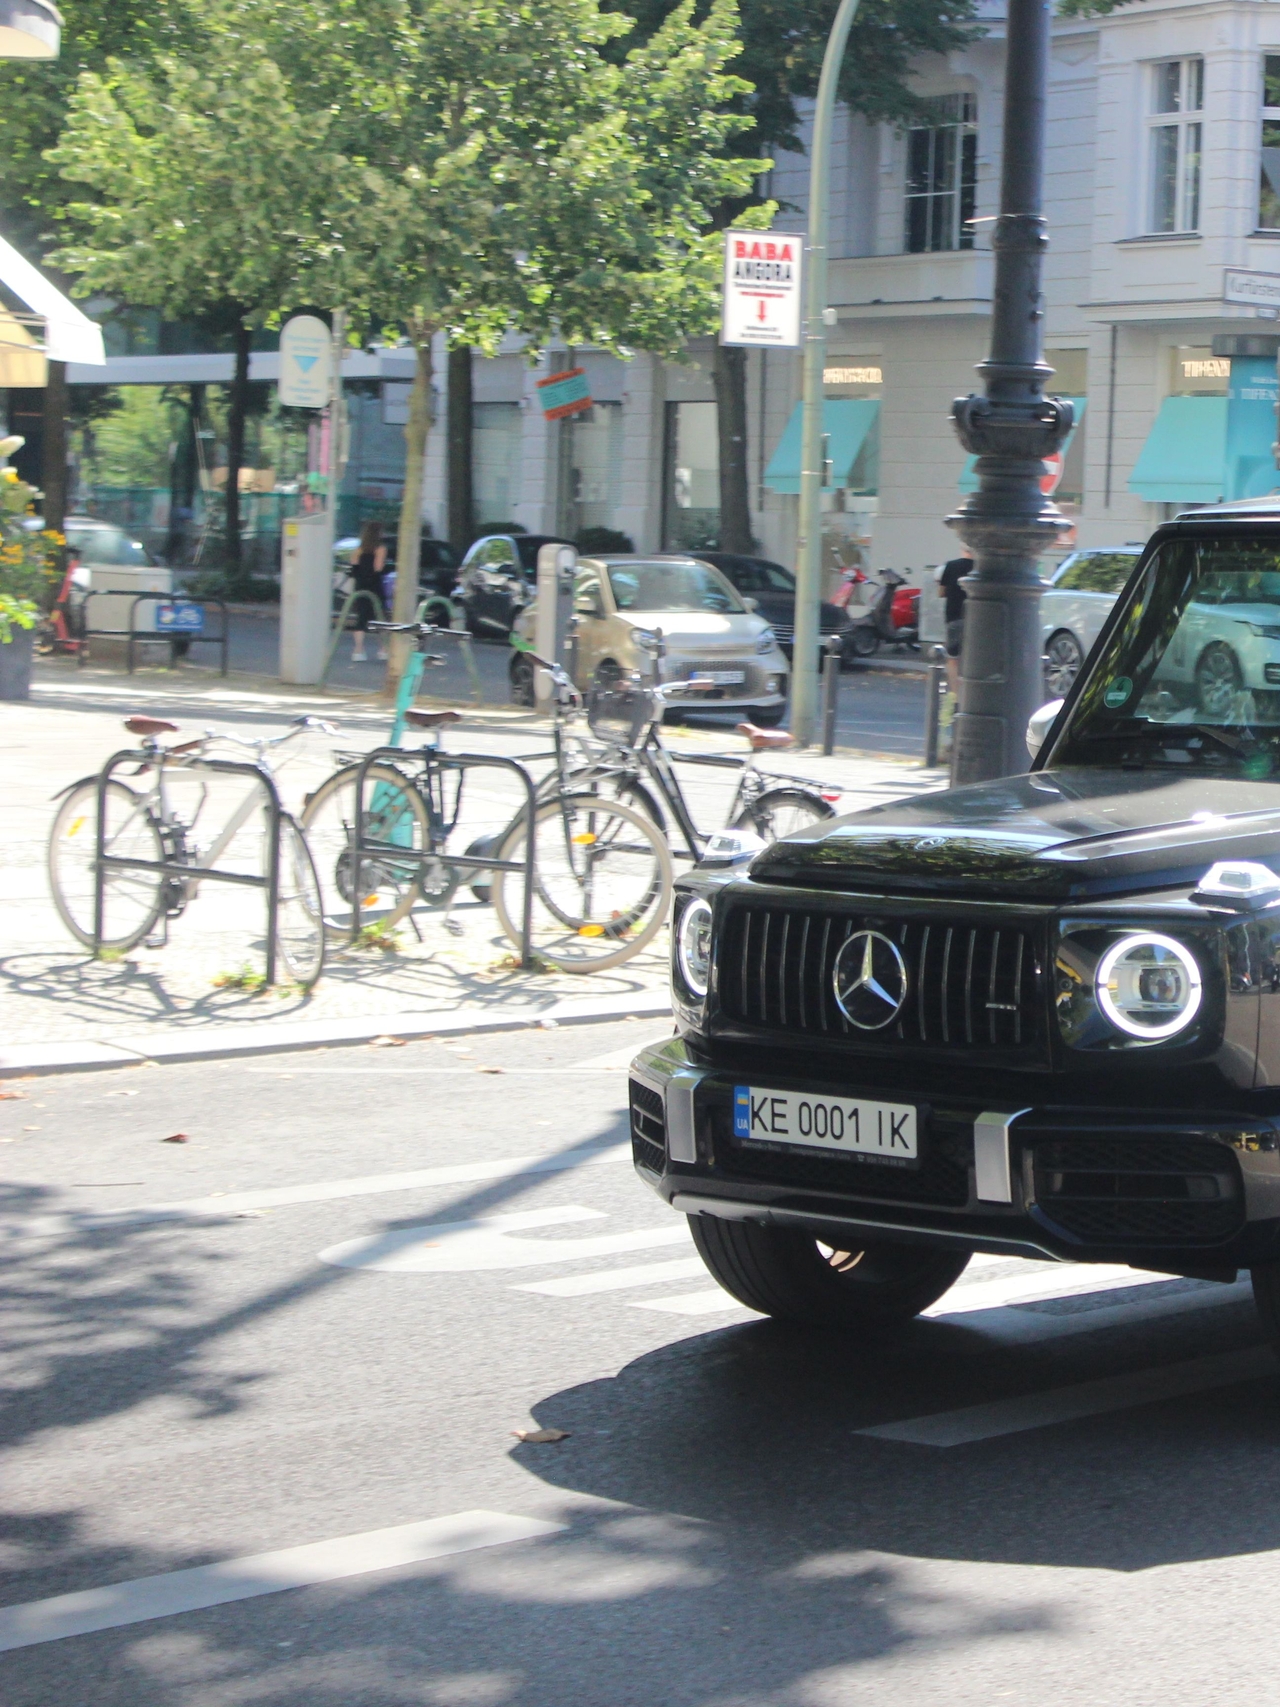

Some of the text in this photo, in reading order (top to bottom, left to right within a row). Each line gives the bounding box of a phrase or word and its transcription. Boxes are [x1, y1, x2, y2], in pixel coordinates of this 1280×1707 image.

[735, 240, 793, 262] BABA
[734, 261, 794, 282] ANGORA
[737, 1118, 748, 1130] UA
[751, 1095, 910, 1149] KE 0001 IK
